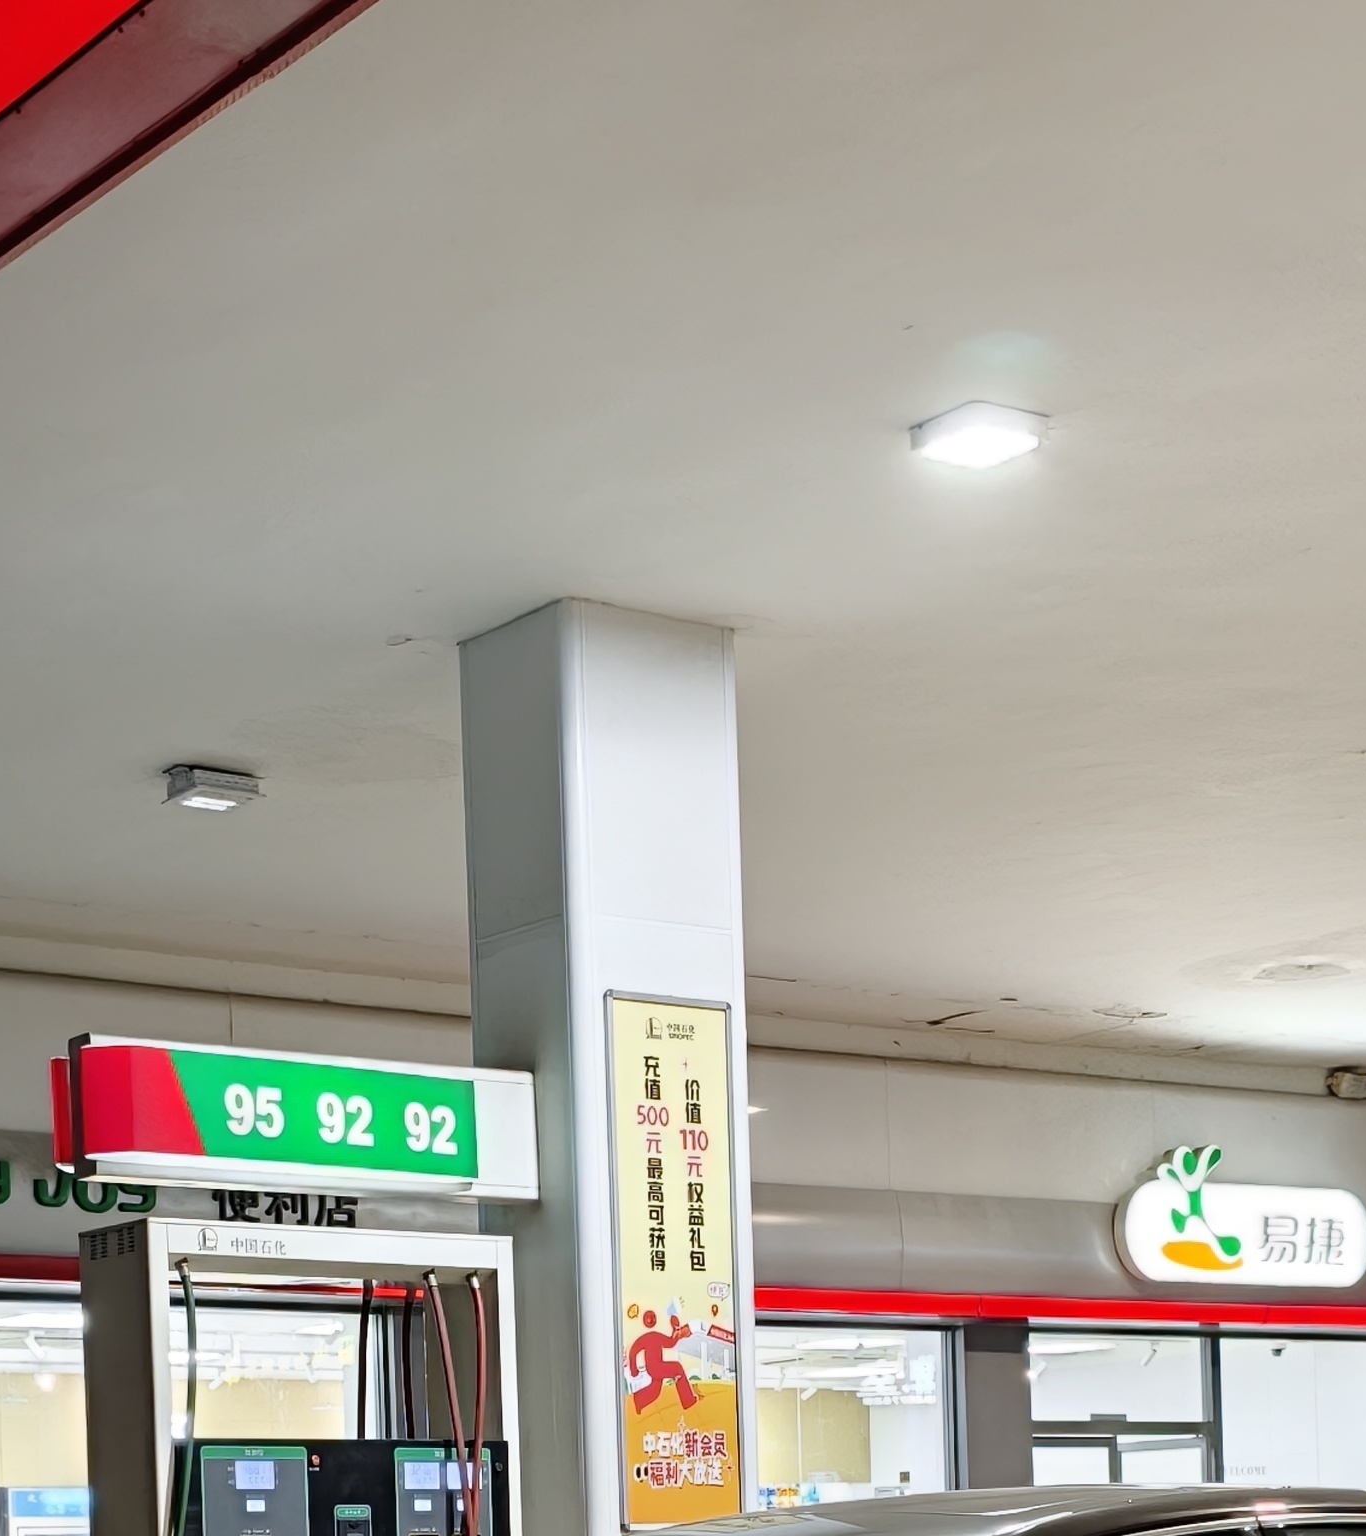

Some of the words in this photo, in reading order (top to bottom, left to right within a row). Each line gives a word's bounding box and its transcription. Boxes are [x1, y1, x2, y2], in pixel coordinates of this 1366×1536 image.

[224, 1083, 285, 1138] 95
[316, 1092, 375, 1147] 92
[404, 1101, 459, 1155] 92
[637, 1055, 670, 1272] 充值500元最高可获得
[679, 1079, 709, 1272] 价值110元权益礼包
[230, 1236, 287, 1256] 中国石化
[1257, 1215, 1345, 1266] 易捷
